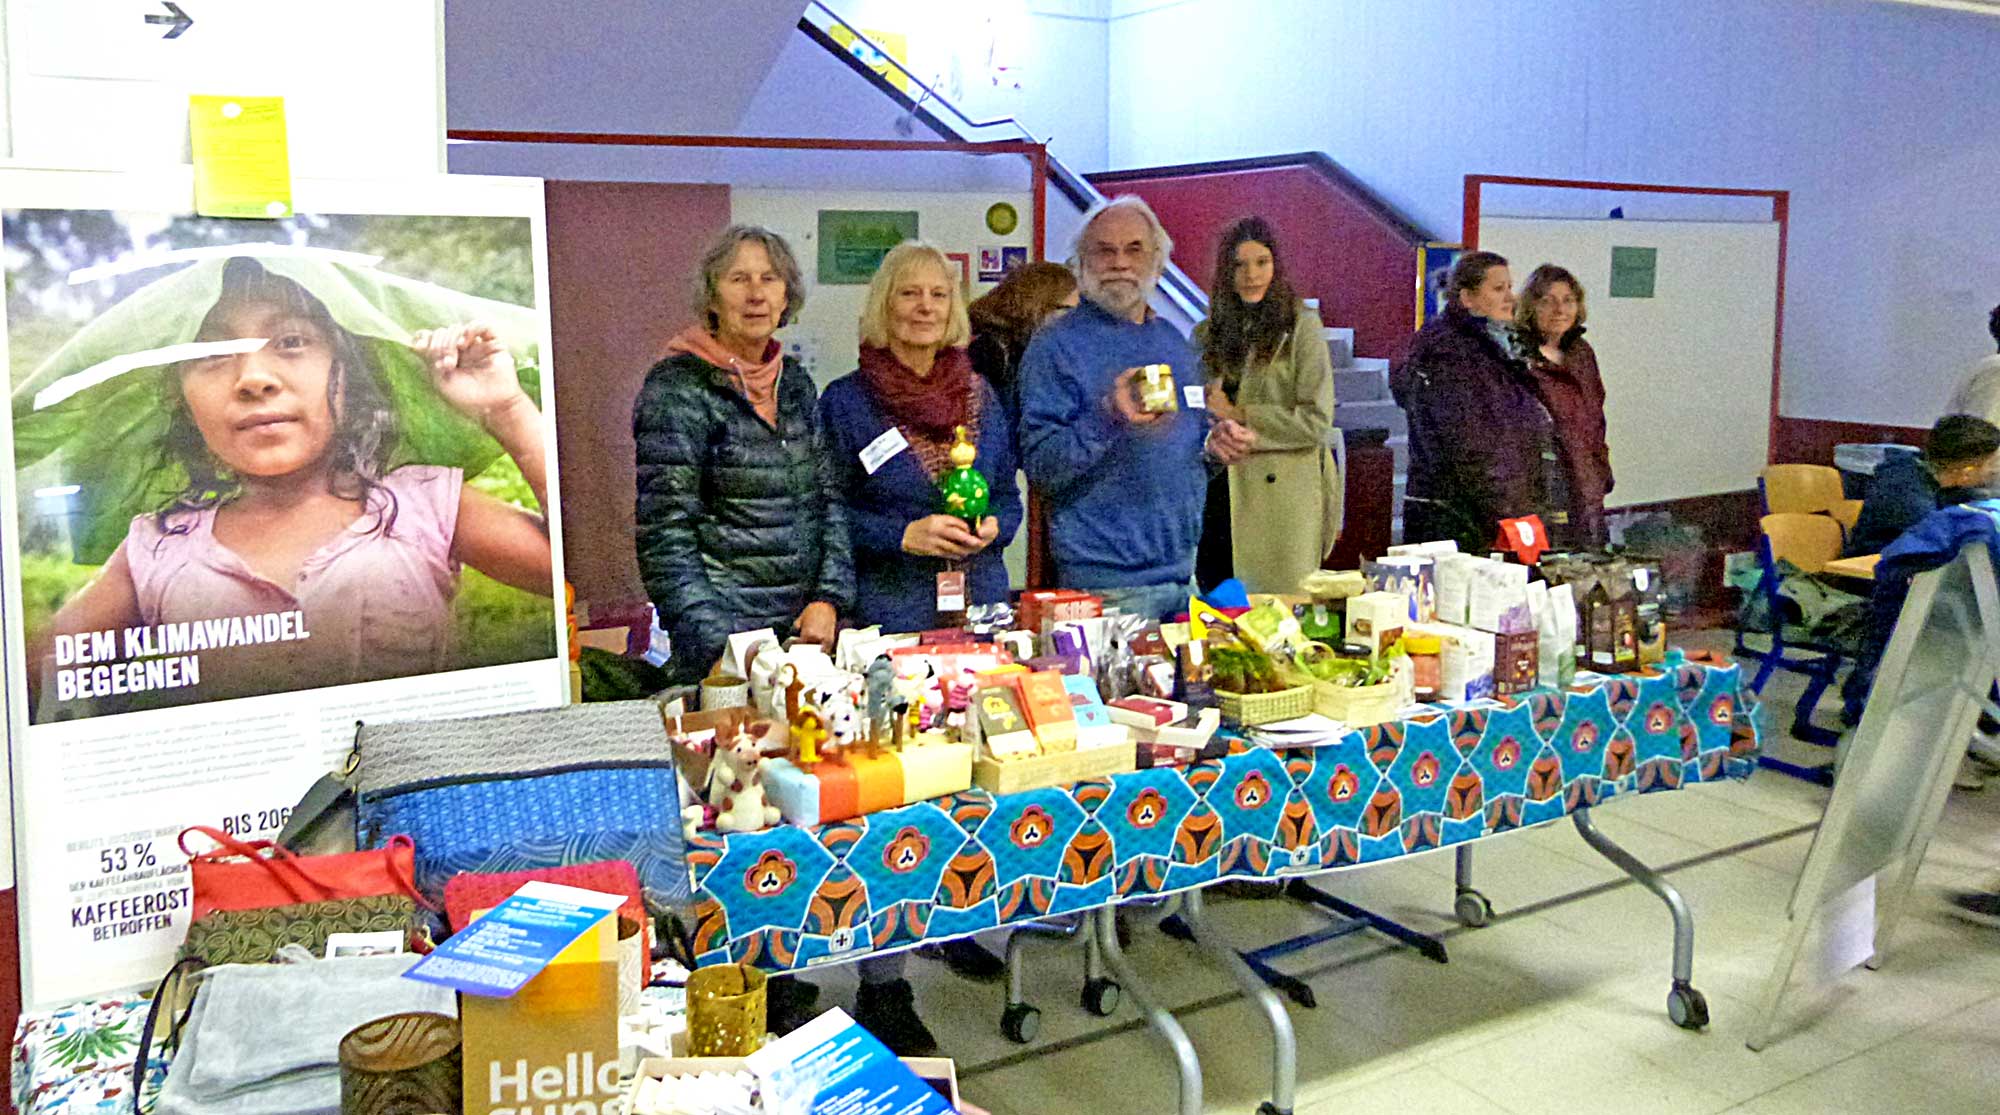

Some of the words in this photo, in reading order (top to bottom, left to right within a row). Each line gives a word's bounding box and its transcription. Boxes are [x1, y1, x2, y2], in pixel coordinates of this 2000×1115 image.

[54, 629, 117, 666] DEM
[124, 610, 310, 658] KLIMAWANDEL
[56, 654, 200, 702] BEGEGNEN
[223, 813, 252, 836] BIS
[258, 806, 297, 831] 206
[100, 847, 128, 874] 53
[134, 842, 156, 868] %
[71, 887, 190, 928] KAFFEEROST
[93, 912, 173, 942] BETROFFEN
[489, 1051, 619, 1104] Hello
